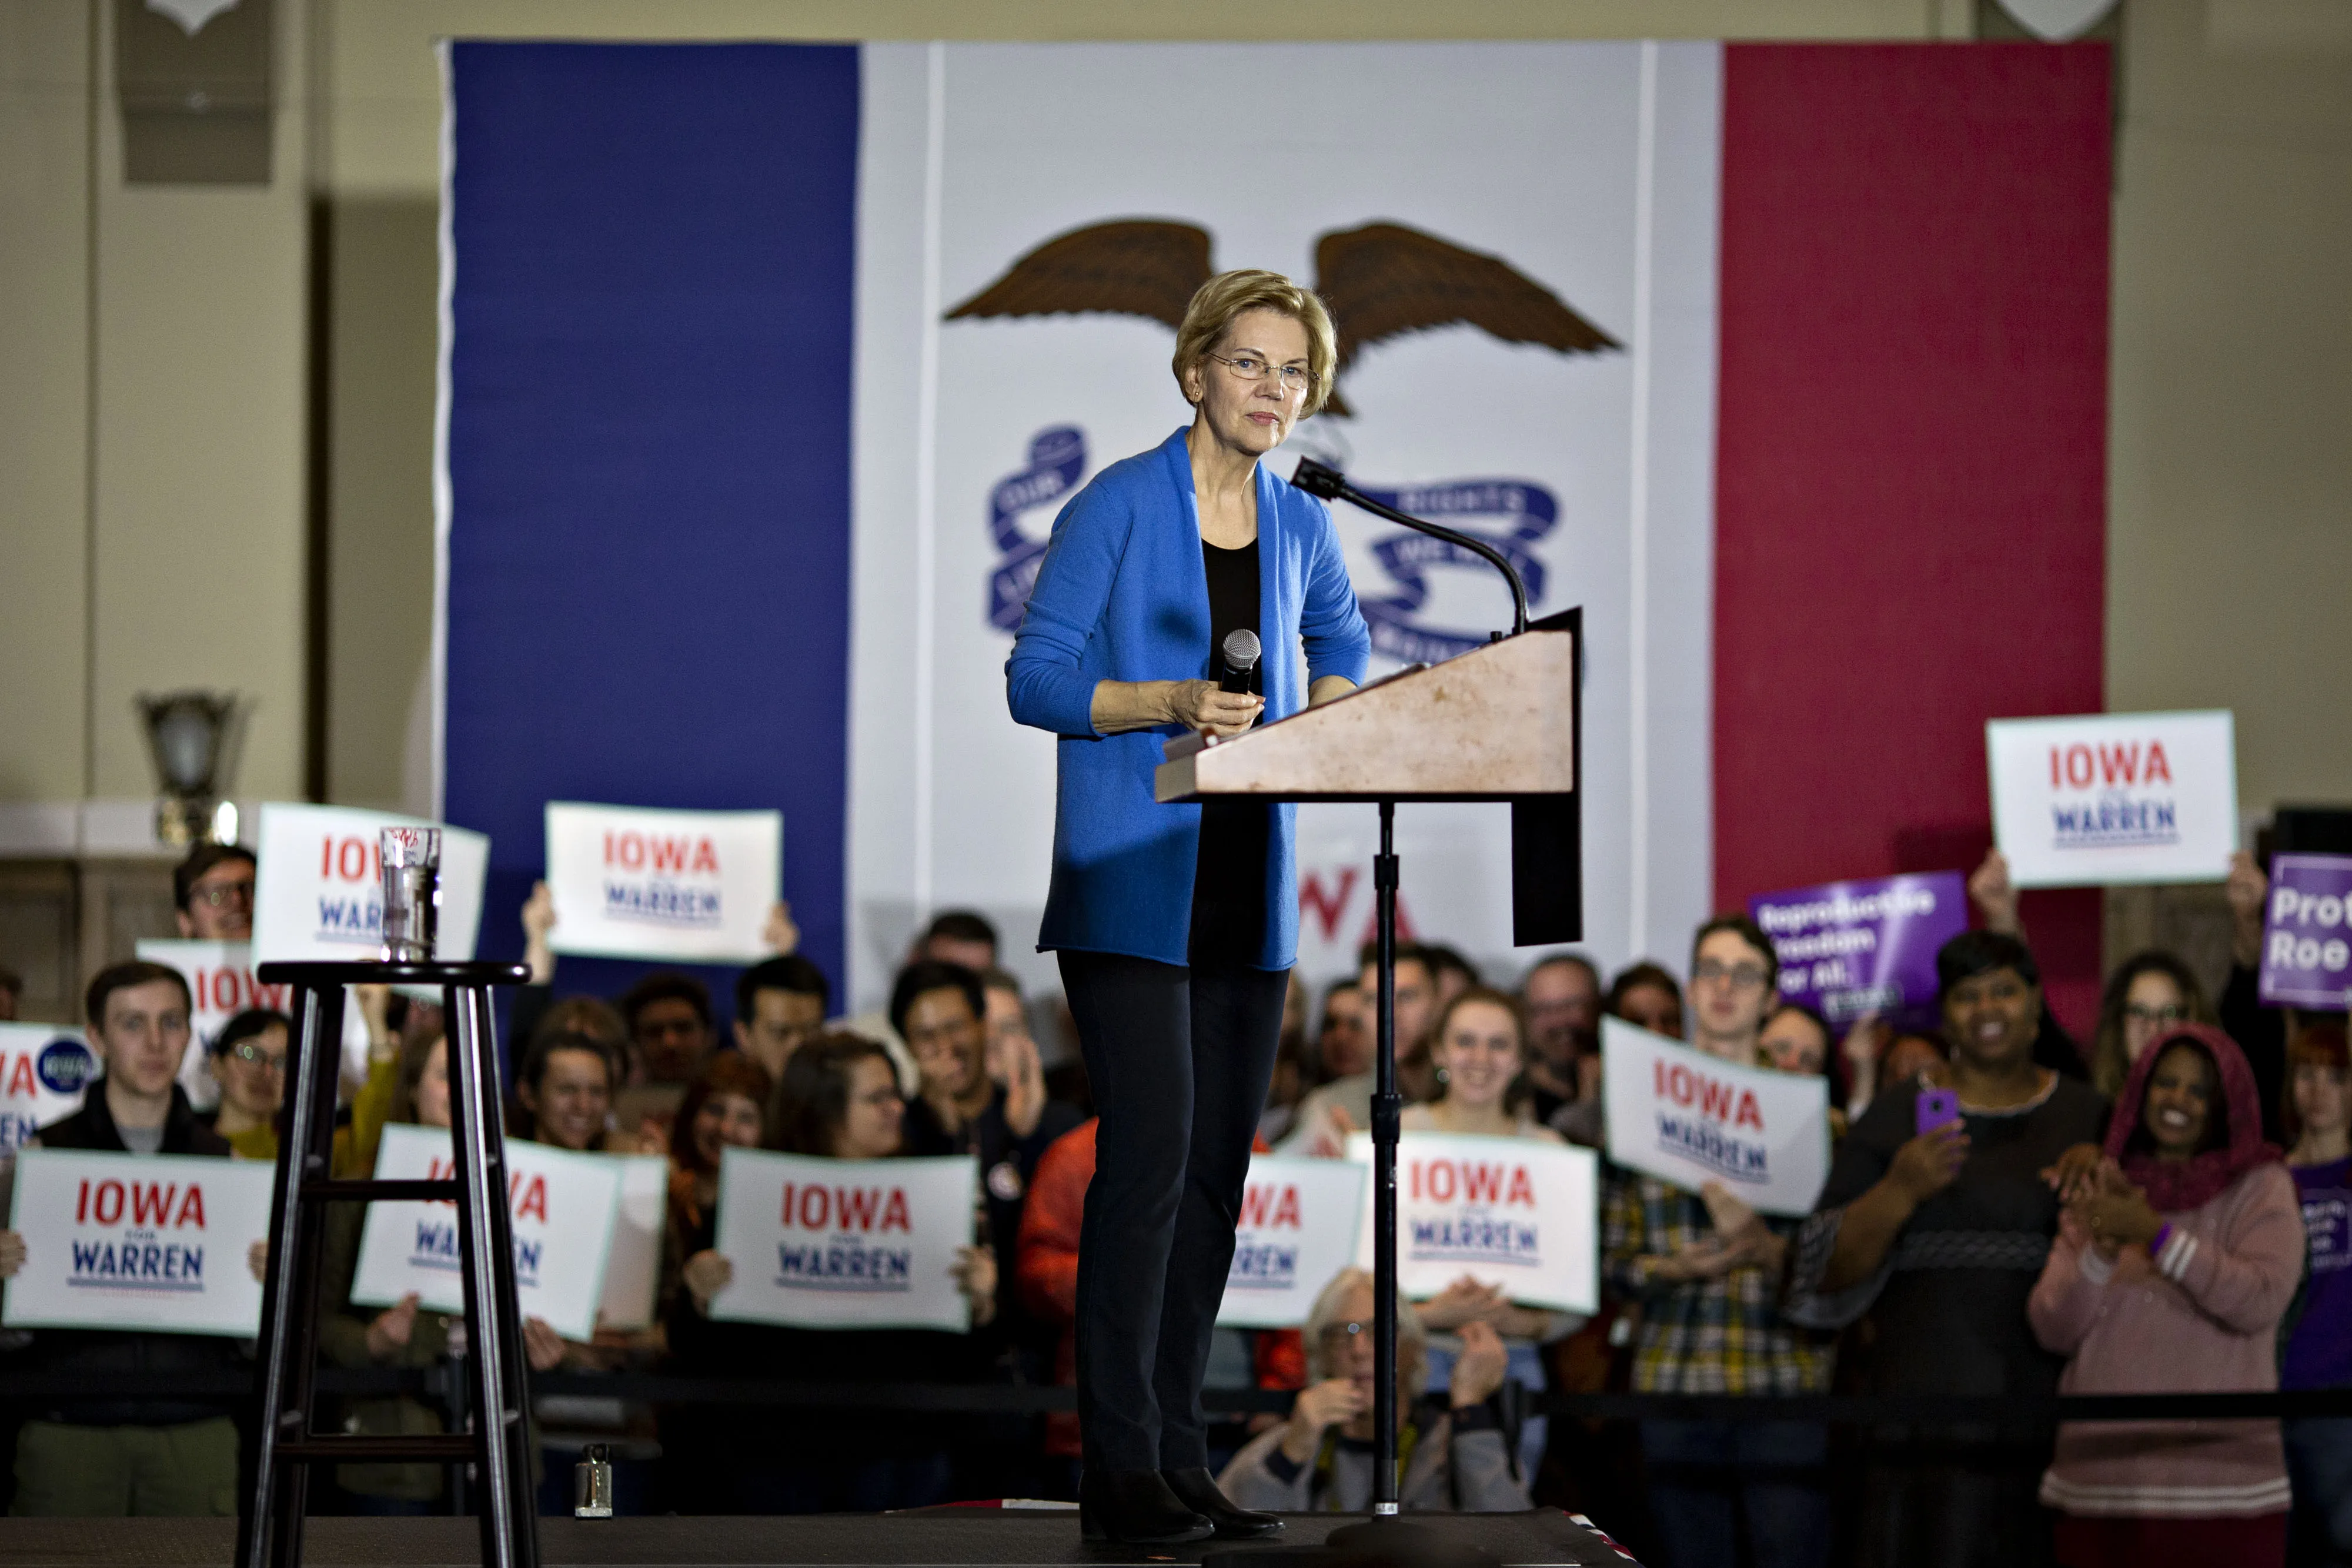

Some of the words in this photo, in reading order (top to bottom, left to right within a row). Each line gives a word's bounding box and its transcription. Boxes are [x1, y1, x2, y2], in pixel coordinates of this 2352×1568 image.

[2049, 739, 2173, 790] IOWA
[2053, 800, 2175, 833] WARREN
[320, 835, 381, 885] IO
[604, 828, 721, 874] IOWA
[604, 881, 720, 914] WARREN
[195, 967, 295, 1014] IOW
[1653, 1058, 1764, 1131] IOWA
[1655, 1111, 1767, 1170] WARREN
[76, 1177, 207, 1230] IOWA
[1409, 1157, 1536, 1209] IOWA
[781, 1182, 911, 1233] IOWA
[1409, 1216, 1538, 1252] WARREN
[72, 1239, 204, 1278] WARREN
[777, 1241, 911, 1279] WARREN
